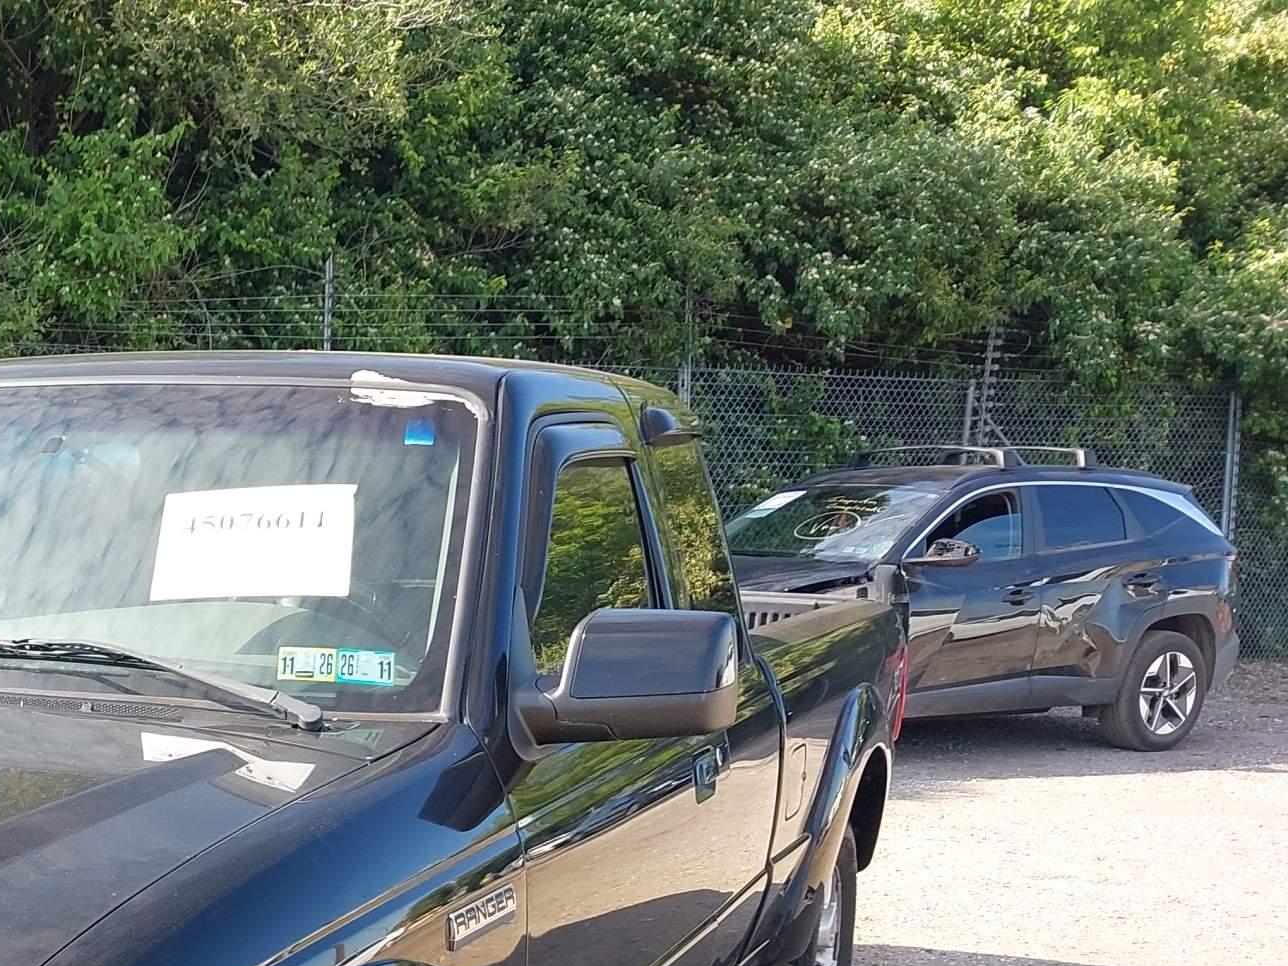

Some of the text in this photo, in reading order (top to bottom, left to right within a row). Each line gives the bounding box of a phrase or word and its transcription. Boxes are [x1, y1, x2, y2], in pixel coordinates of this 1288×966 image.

[184, 511, 326, 534] 45076611
[319, 653, 334, 675] 26
[340, 654, 354, 676] 26
[453, 887, 516, 936] RANGER
